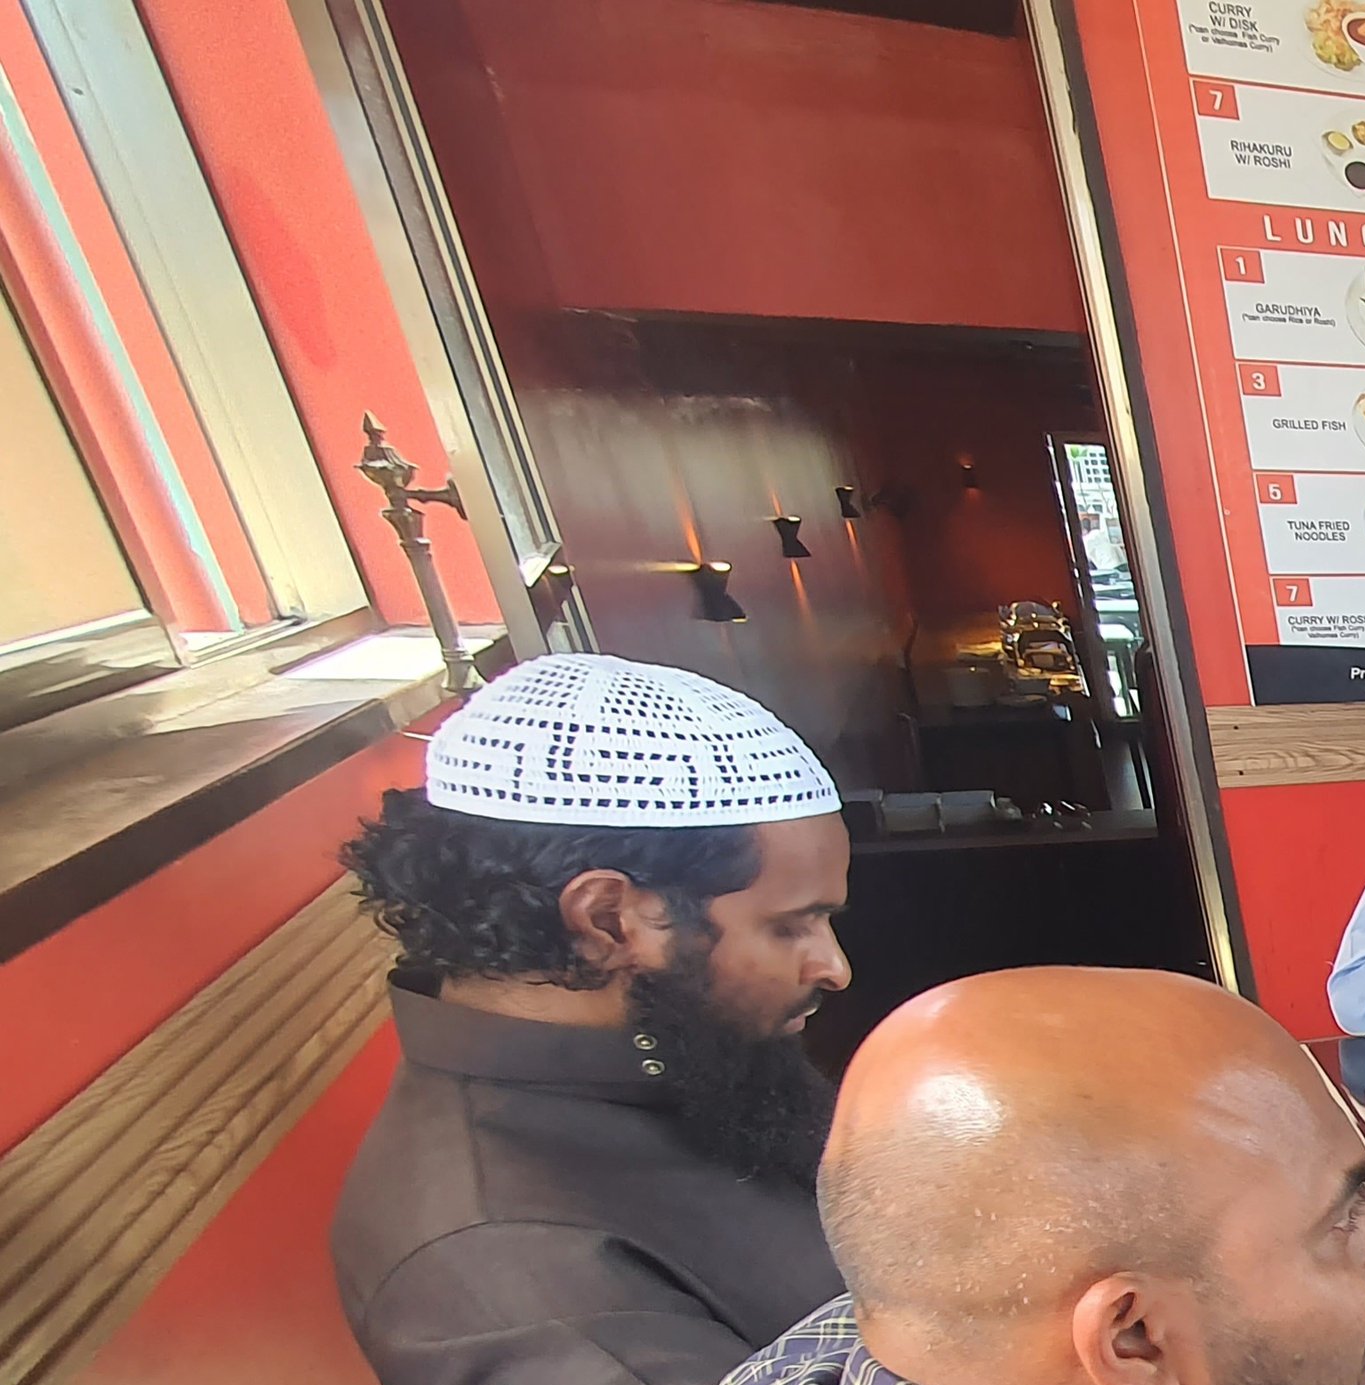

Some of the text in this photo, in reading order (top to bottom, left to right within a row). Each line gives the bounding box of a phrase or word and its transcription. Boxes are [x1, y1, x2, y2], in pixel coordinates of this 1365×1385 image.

[1208, 1, 1252, 18] CURRY
[1229, 17, 1259, 32] DISK
[1208, 89, 1223, 111] 7
[1230, 139, 1292, 157] RIHAKURU
[1253, 155, 1291, 169] ROSHI
[1235, 256, 1246, 275] 1
[1255, 303, 1321, 317] GARUDHIYA
[1251, 372, 1266, 390] 3
[1272, 418, 1347, 431] GRILLED FISH
[1287, 520, 1350, 531] TUNA FRIED
[1294, 531, 1346, 541] NOODLES
[1285, 585, 1299, 602] 7
[1287, 615, 1324, 626] CURRY
